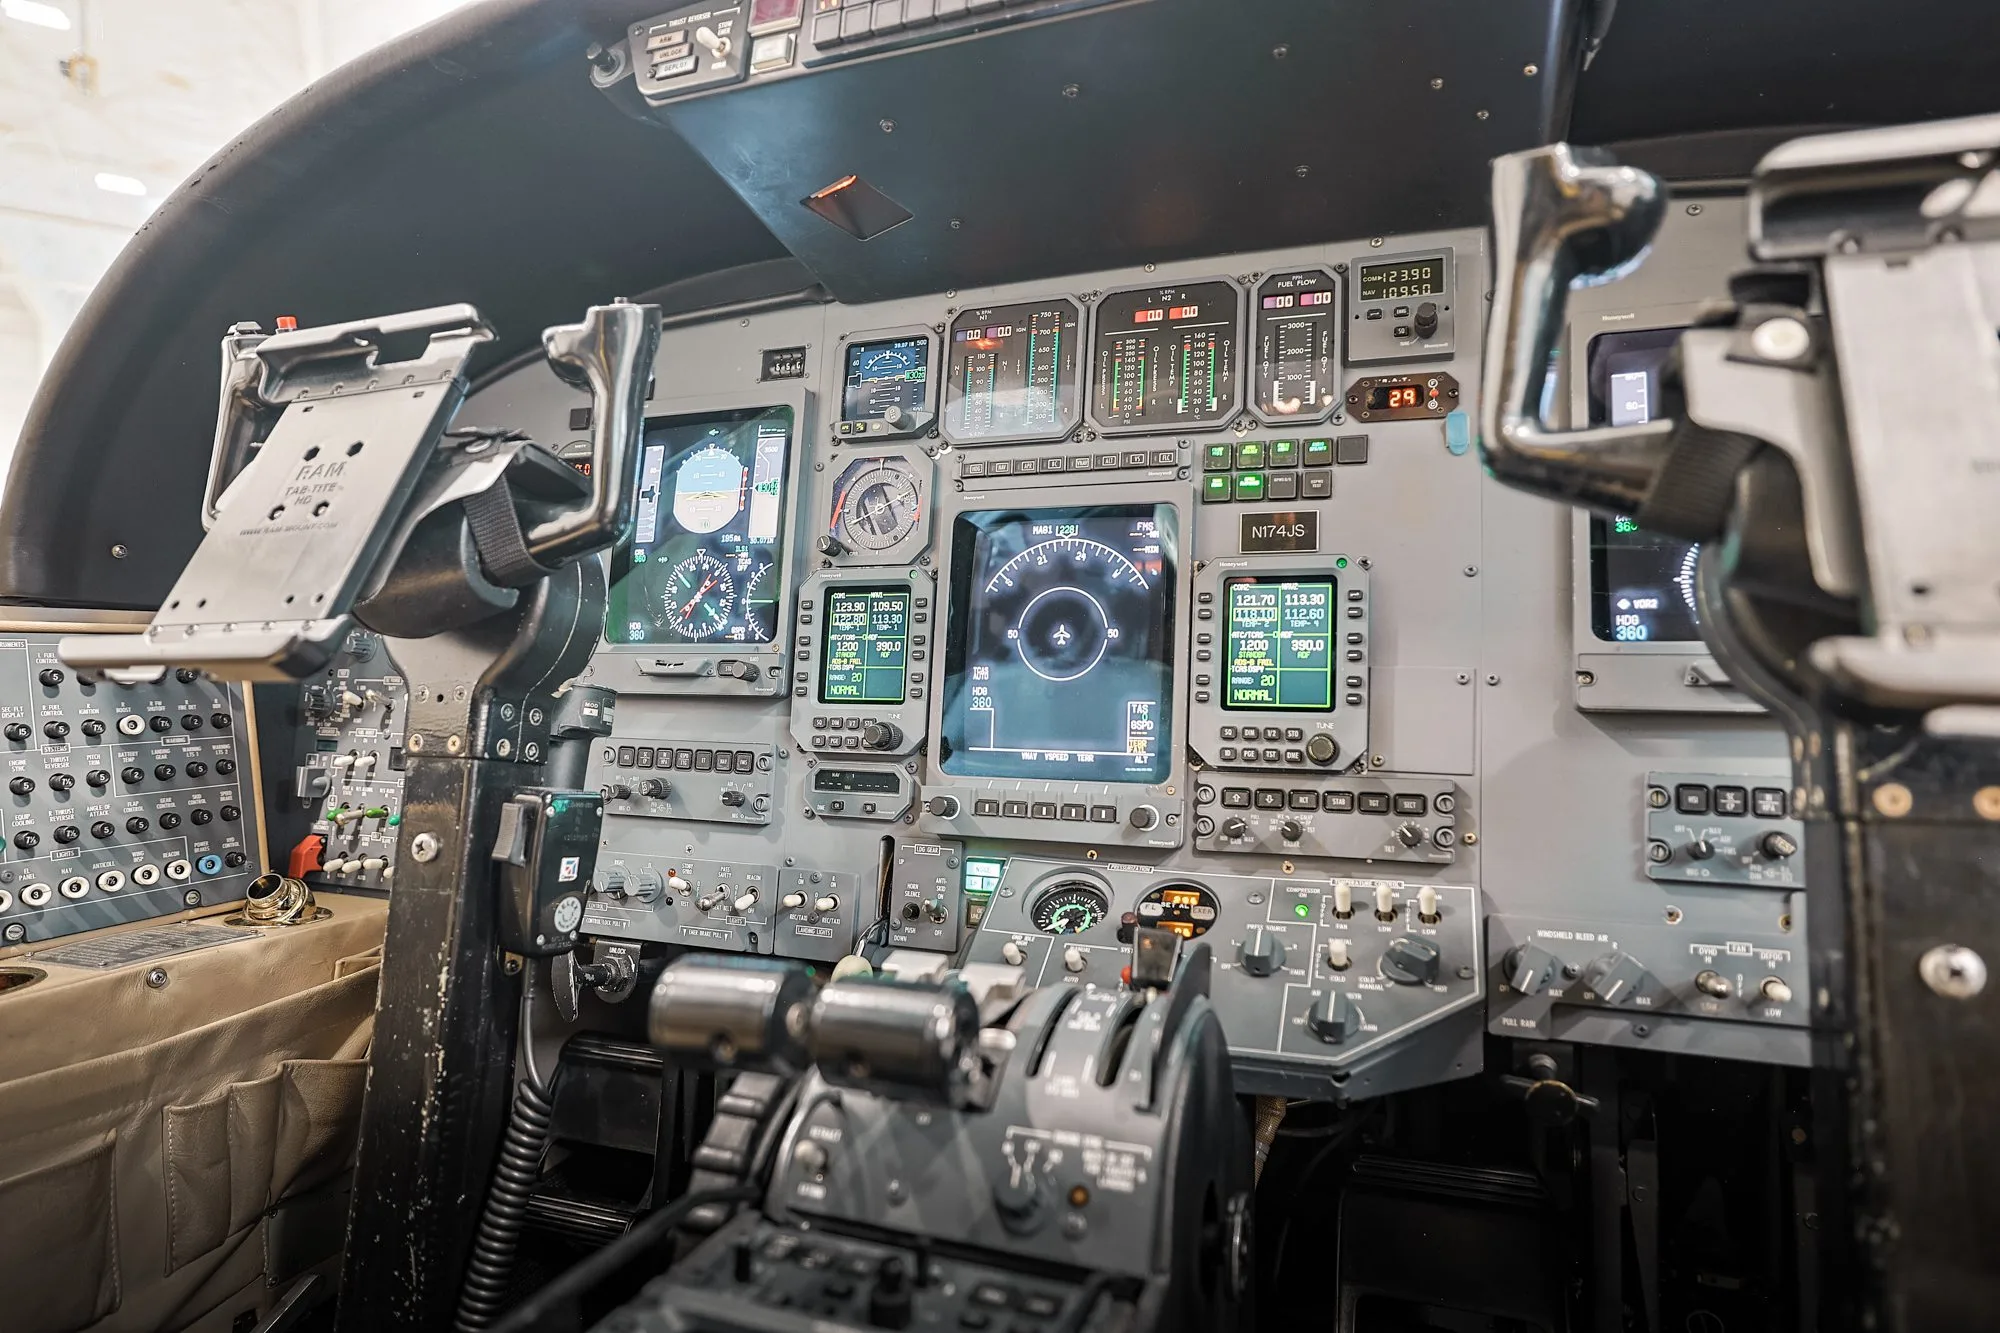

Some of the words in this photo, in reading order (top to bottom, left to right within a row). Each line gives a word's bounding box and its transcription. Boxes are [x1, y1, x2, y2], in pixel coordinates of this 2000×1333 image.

[1382, 268, 1431, 282] 123.90
[1382, 284, 1431, 299] 109.50
[1277, 296, 1293, 308] 00
[1314, 292, 1331, 304] 00
[1148, 309, 1163, 321] 0.0
[1182, 306, 1198, 318] 0.0
[967, 330, 980, 340] 0.0
[998, 326, 1011, 336] 0.0
[1389, 390, 1416, 407] 29
[1059, 526, 1074, 534] 228
[1137, 523, 1154, 531] FMS
[1252, 524, 1305, 538] N174JS
[1037, 555, 1048, 565] 21
[1075, 552, 1087, 561] 24
[1236, 595, 1275, 606] 121.70
[1633, 599, 1658, 609] VOR2
[835, 602, 865, 612] 123.90
[873, 602, 903, 611] 109.50
[872, 614, 902, 624] 113.30
[1236, 609, 1274, 619] 118.10
[1285, 609, 1324, 619] 112.60
[835, 615, 864, 624] 122.80
[1616, 615, 1639, 625] HDG
[629, 630, 644, 640] 360
[1008, 630, 1018, 639] 50
[1108, 629, 1119, 638] 50
[1616, 626, 1645, 640] 360
[836, 642, 858, 651] 1200
[876, 642, 900, 651] 390.0
[1240, 640, 1268, 650] 1200
[1291, 640, 1324, 650] 390.0
[1261, 675, 1274, 686] 20
[831, 686, 859, 695] NORMAL
[1234, 690, 1272, 700] NORMAL
[973, 697, 992, 708] 360
[1132, 705, 1148, 714] TAS
[1022, 752, 1037, 760] VNAV
[1045, 753, 1069, 762] VSPEED
[1077, 754, 1094, 762] TERR
[1134, 756, 1148, 764] ALT
[1538, 930, 1572, 940] WINDSHIELD
[1576, 933, 1594, 941] BLEED
[1597, 934, 1608, 942] AIR
[1699, 947, 1717, 956] OVHD
[1731, 945, 1746, 953] FAN
[1761, 952, 1782, 961] DEFOG
[1765, 1008, 1781, 1017] LOW
[1502, 1018, 1517, 1026] PULL
[1520, 1019, 1536, 1028] RAIN
